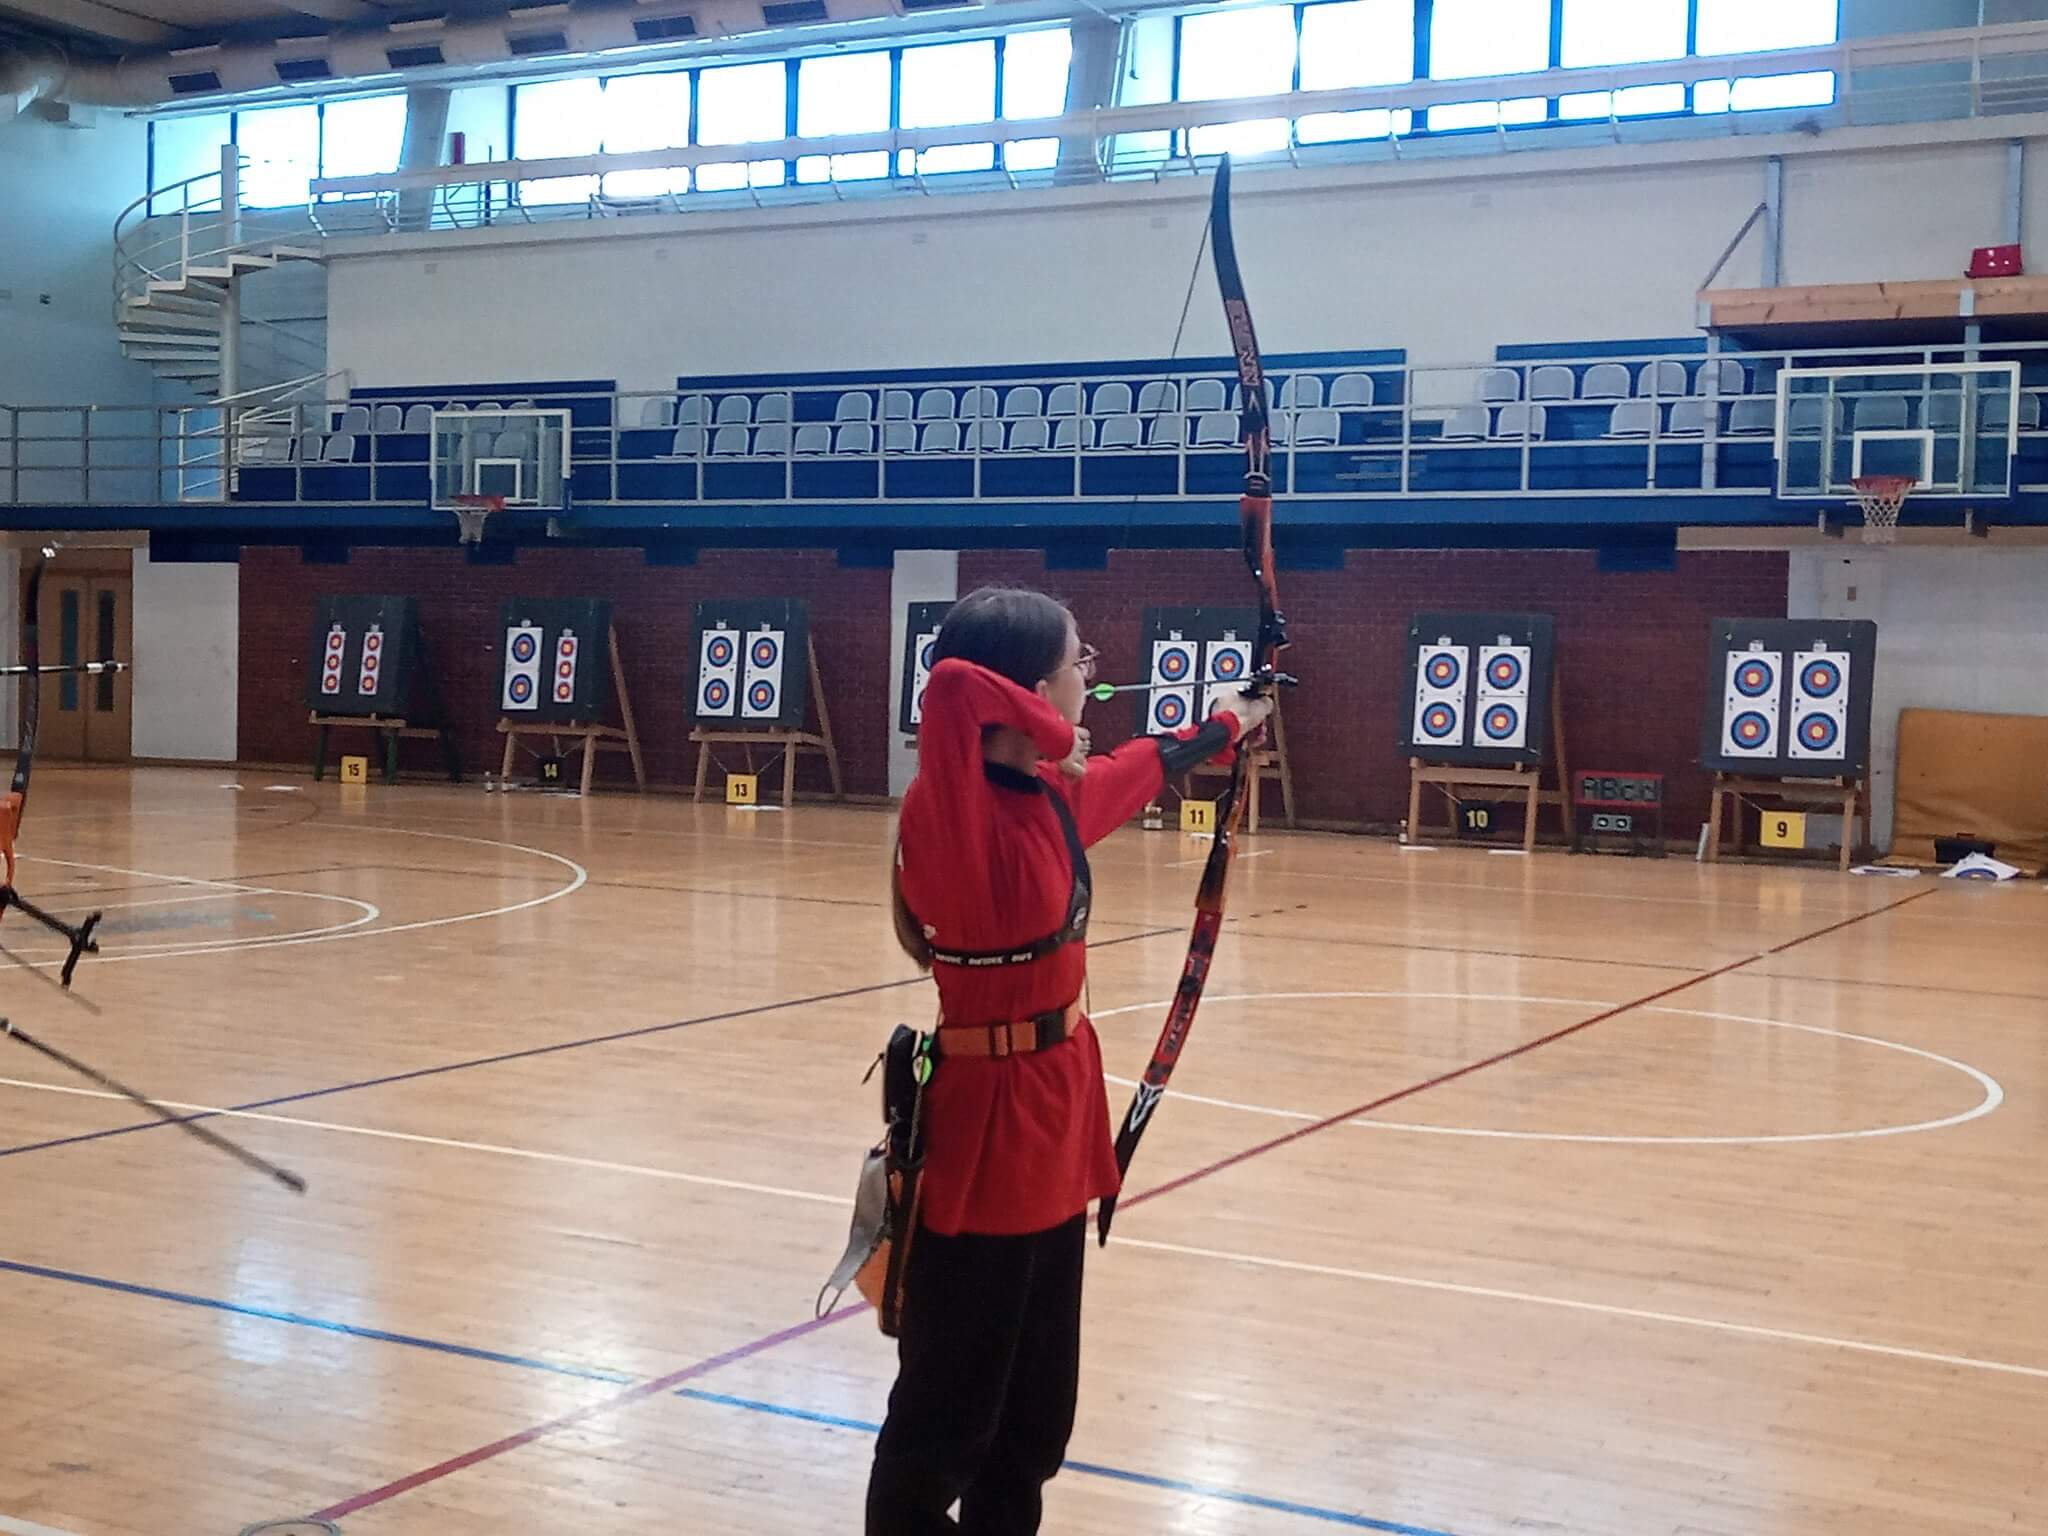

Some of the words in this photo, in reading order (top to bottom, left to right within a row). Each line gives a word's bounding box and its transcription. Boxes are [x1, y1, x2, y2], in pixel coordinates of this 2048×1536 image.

[544, 763, 557, 777] 14
[735, 783, 747, 797] 13
[1190, 809, 1204, 825] 11
[1466, 810, 1488, 828] 10
[1776, 821, 1788, 838] 9
